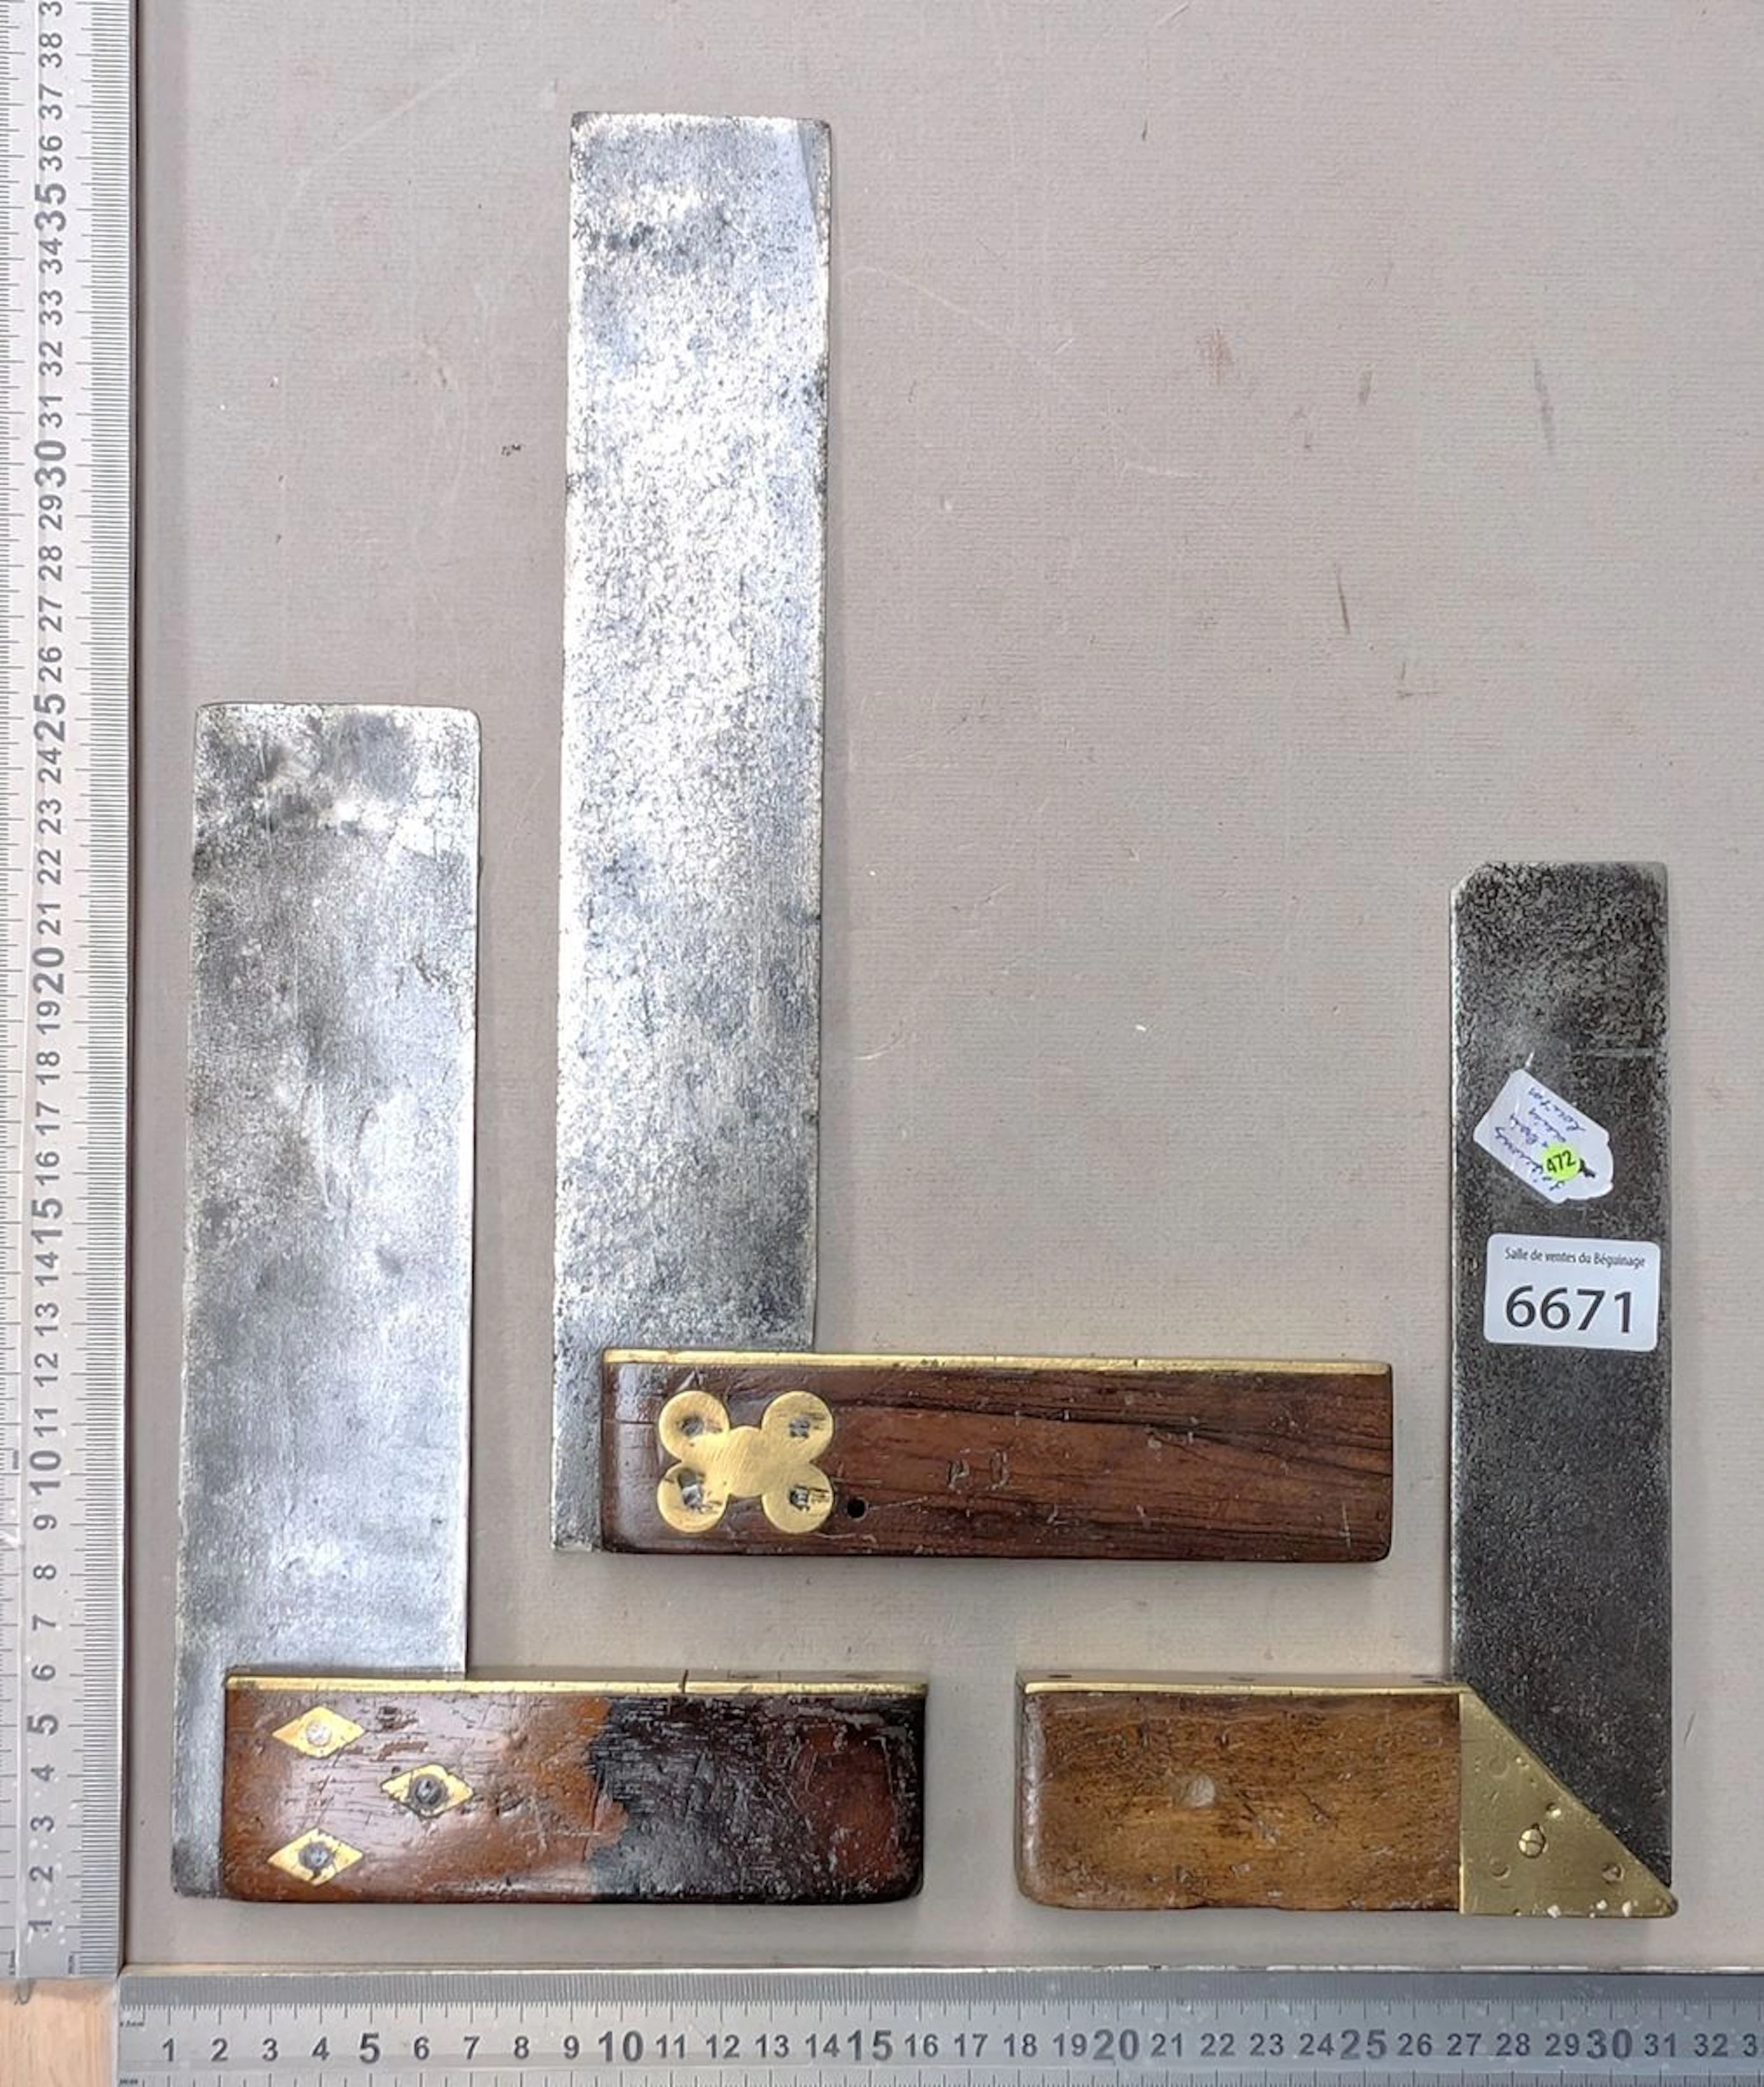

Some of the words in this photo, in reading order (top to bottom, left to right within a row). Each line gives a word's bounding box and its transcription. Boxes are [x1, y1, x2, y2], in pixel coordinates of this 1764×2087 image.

[38, 32, 63, 68] 38
[38, 82, 63, 120] 37
[38, 135, 63, 172] 36
[34, 183, 67, 233] 35
[38, 237, 63, 276] 34
[38, 290, 63, 327] 33
[38, 339, 63, 377] 32
[38, 395, 62, 429] 31
[34, 439, 67, 489] 30
[38, 494, 63, 531] 29
[38, 545, 62, 582] 28
[38, 595, 62, 632] 27
[38, 646, 62, 683] 26
[33, 694, 66, 742] 25
[36, 747, 62, 785] 24
[36, 798, 62, 835] 23
[35, 849, 61, 886] 22
[34, 902, 61, 936] 21
[31, 947, 65, 995] 20
[34, 1000, 61, 1035] 19
[34, 1051, 60, 1085] 18
[34, 1101, 60, 1136] 17
[34, 1151, 60, 1186] 16
[1546, 1151, 1576, 1173] 472
[29, 1198, 63, 1245] 15
[34, 1251, 59, 1287] 14
[1504, 1247, 1528, 1261] Salle
[1531, 1249, 1543, 1261] de
[1545, 1251, 1576, 1263] ventes
[1578, 1252, 1592, 1264] du
[1594, 1252, 1645, 1269] Béguinage
[34, 1303, 59, 1337] 13
[1505, 1285, 1632, 1333] 6671
[33, 1353, 58, 1388] 12
[33, 1408, 58, 1438] 11
[28, 1450, 62, 1495] 10
[33, 1514, 57, 1530] 9
[33, 1564, 57, 1580] 8
[32, 1614, 57, 1631] 7
[31, 1664, 56, 1681] 6
[26, 1714, 59, 1735] 5
[30, 1765, 55, 1782] 4
[29, 1816, 55, 1833] 3
[28, 1866, 53, 1883] 2
[163, 2038, 174, 2062] 1
[211, 2038, 228, 2062] 2
[262, 2038, 278, 2062] 3
[312, 2037, 329, 2061] 4
[360, 2033, 380, 2064] 5
[414, 2036, 429, 2060] 6
[464, 2036, 480, 2060] 7
[514, 2036, 529, 2060] 8
[564, 2035, 579, 2059] 9
[598, 2031, 644, 2063] 10
[656, 2034, 684, 2059] 11
[706, 2034, 740, 2059] 12
[756, 2034, 789, 2058] 13
[805, 2034, 840, 2058] 14
[848, 2030, 892, 2061] 15
[905, 2033, 938, 2058] 16
[955, 2033, 988, 2057] 17
[1004, 2033, 1037, 2057] 18
[1054, 2033, 1086, 2056] 19
[1093, 2030, 1139, 2060] 20
[1151, 2033, 1182, 2056] 21
[1201, 2033, 1233, 2056] 22
[1250, 2033, 1283, 2056] 23
[1300, 2033, 1334, 2055] 24
[1341, 2030, 1386, 2059] 25
[1399, 2033, 1432, 2056] 26
[1447, 2034, 1481, 2056] 27
[1496, 2033, 1530, 2056] 28
[1546, 2034, 1579, 2056] 29
[1587, 2029, 1632, 2059] 30
[1645, 2034, 1675, 2056] 31
[1694, 2034, 1728, 2057] 32
